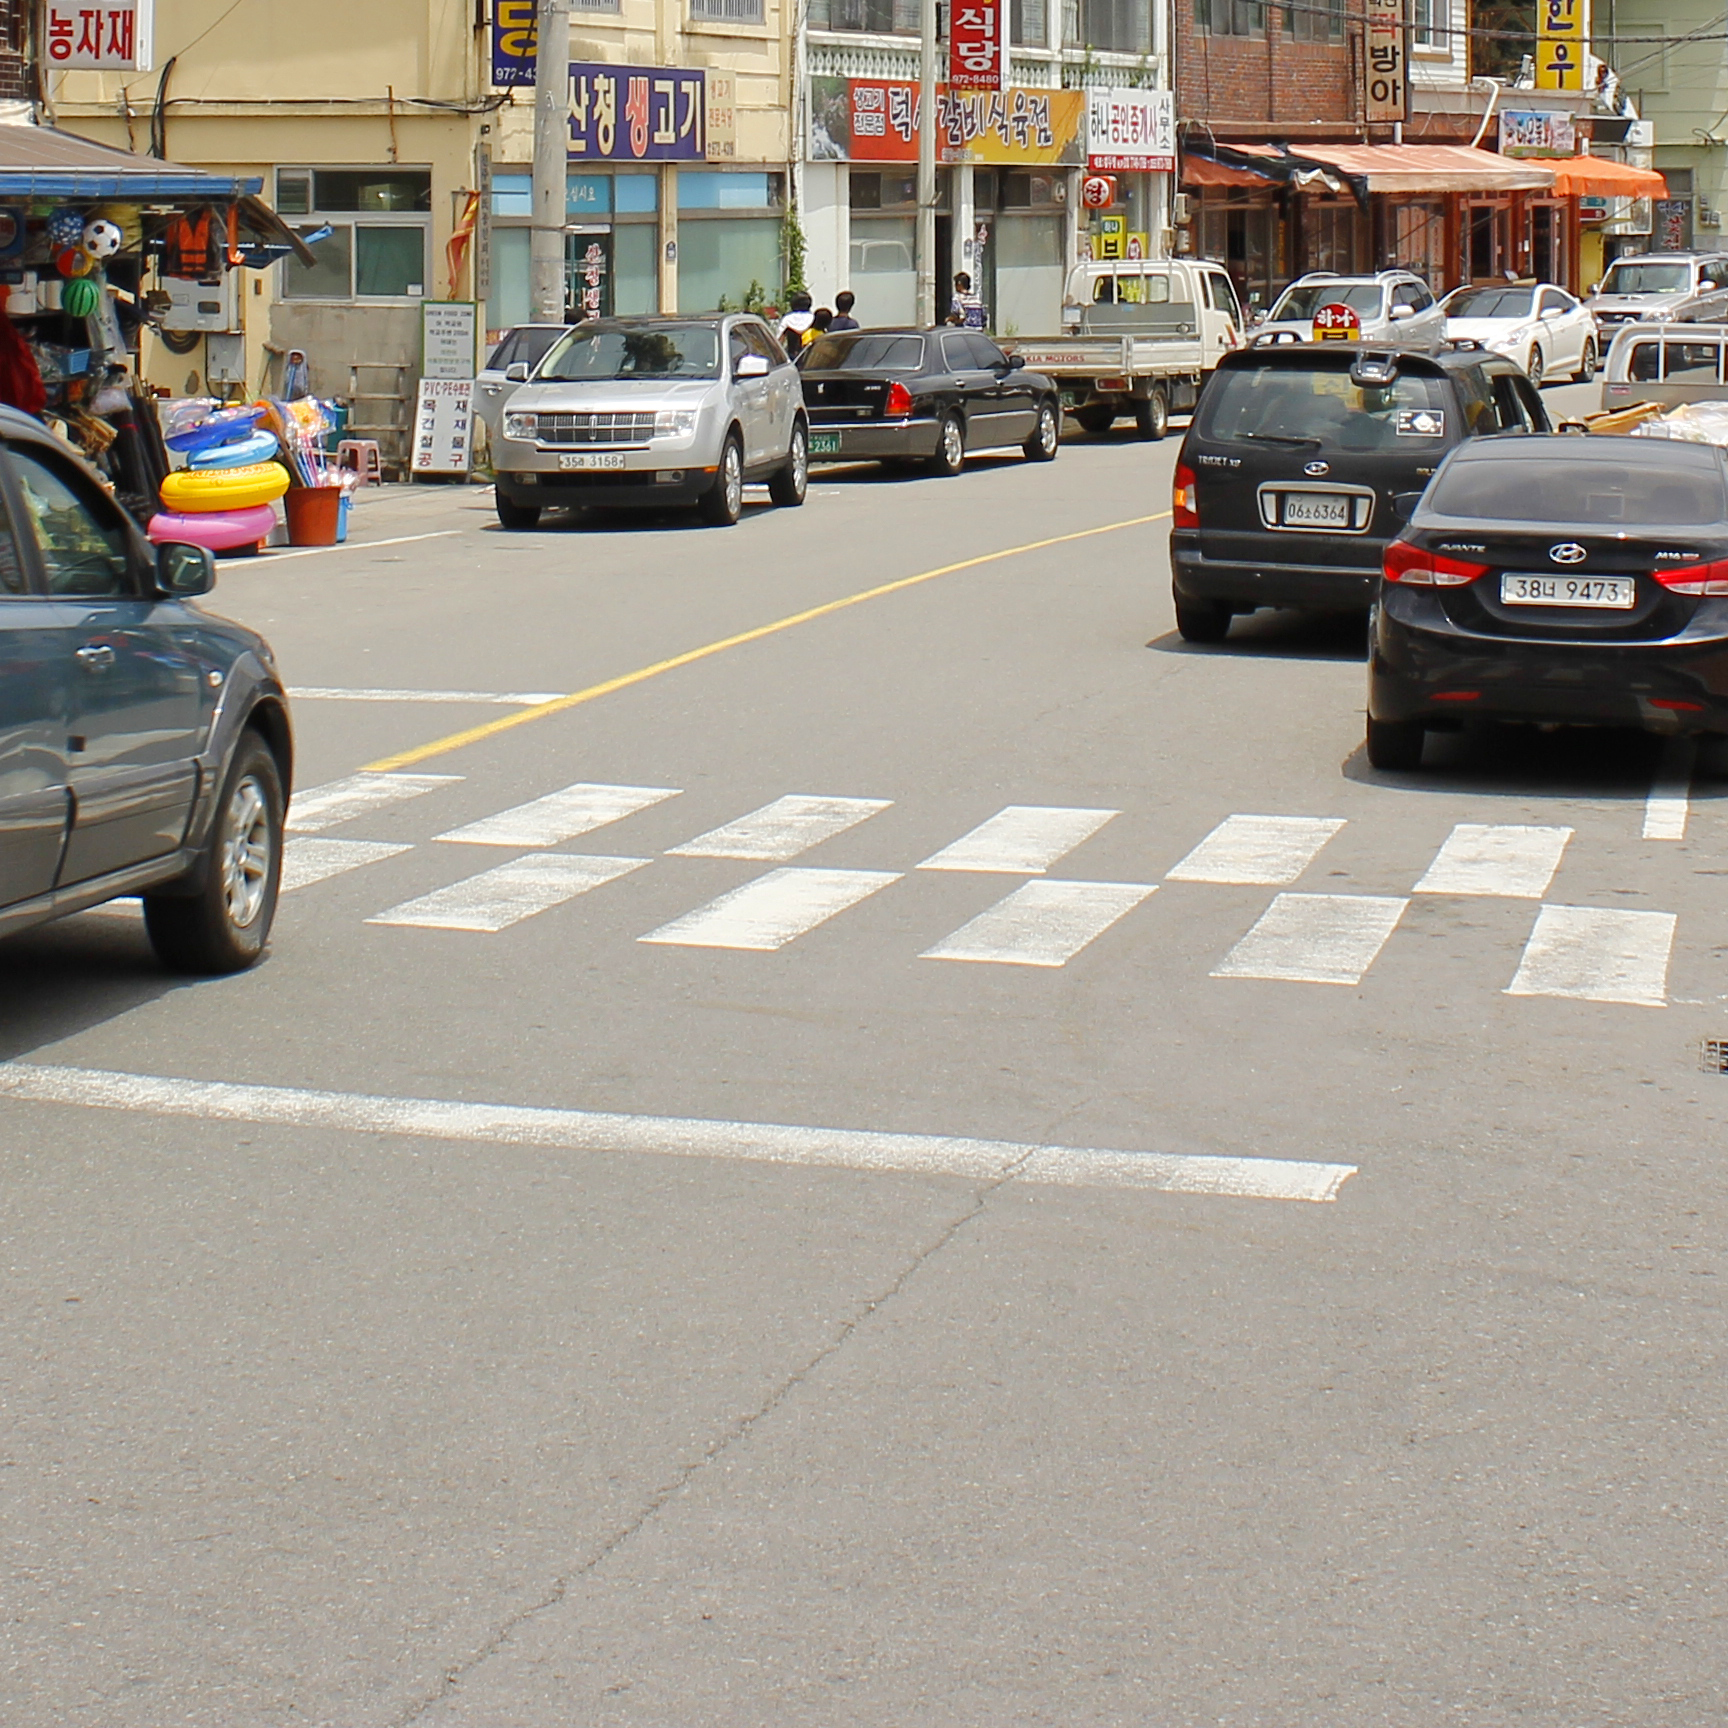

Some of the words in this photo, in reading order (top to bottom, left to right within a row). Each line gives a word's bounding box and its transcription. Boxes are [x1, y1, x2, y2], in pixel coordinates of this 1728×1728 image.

[48, 8, 135, 61] 농자재
[853, 87, 885, 112] 생고기
[567, 73, 617, 157] 산청
[625, 76, 702, 158] 생고기
[1091, 102, 1110, 145] 하나
[1111, 104, 1158, 145] 공인중개사
[1316, 308, 1355, 328] 하나
[1046, 355, 1086, 364] MOTORS
[418, 452, 464, 468] 공구
[589, 454, 619, 468] 3158
[1288, 502, 1346, 521] 06소6364
[1515, 579, 1556, 599] 38너
[1566, 583, 1619, 602] 9473
